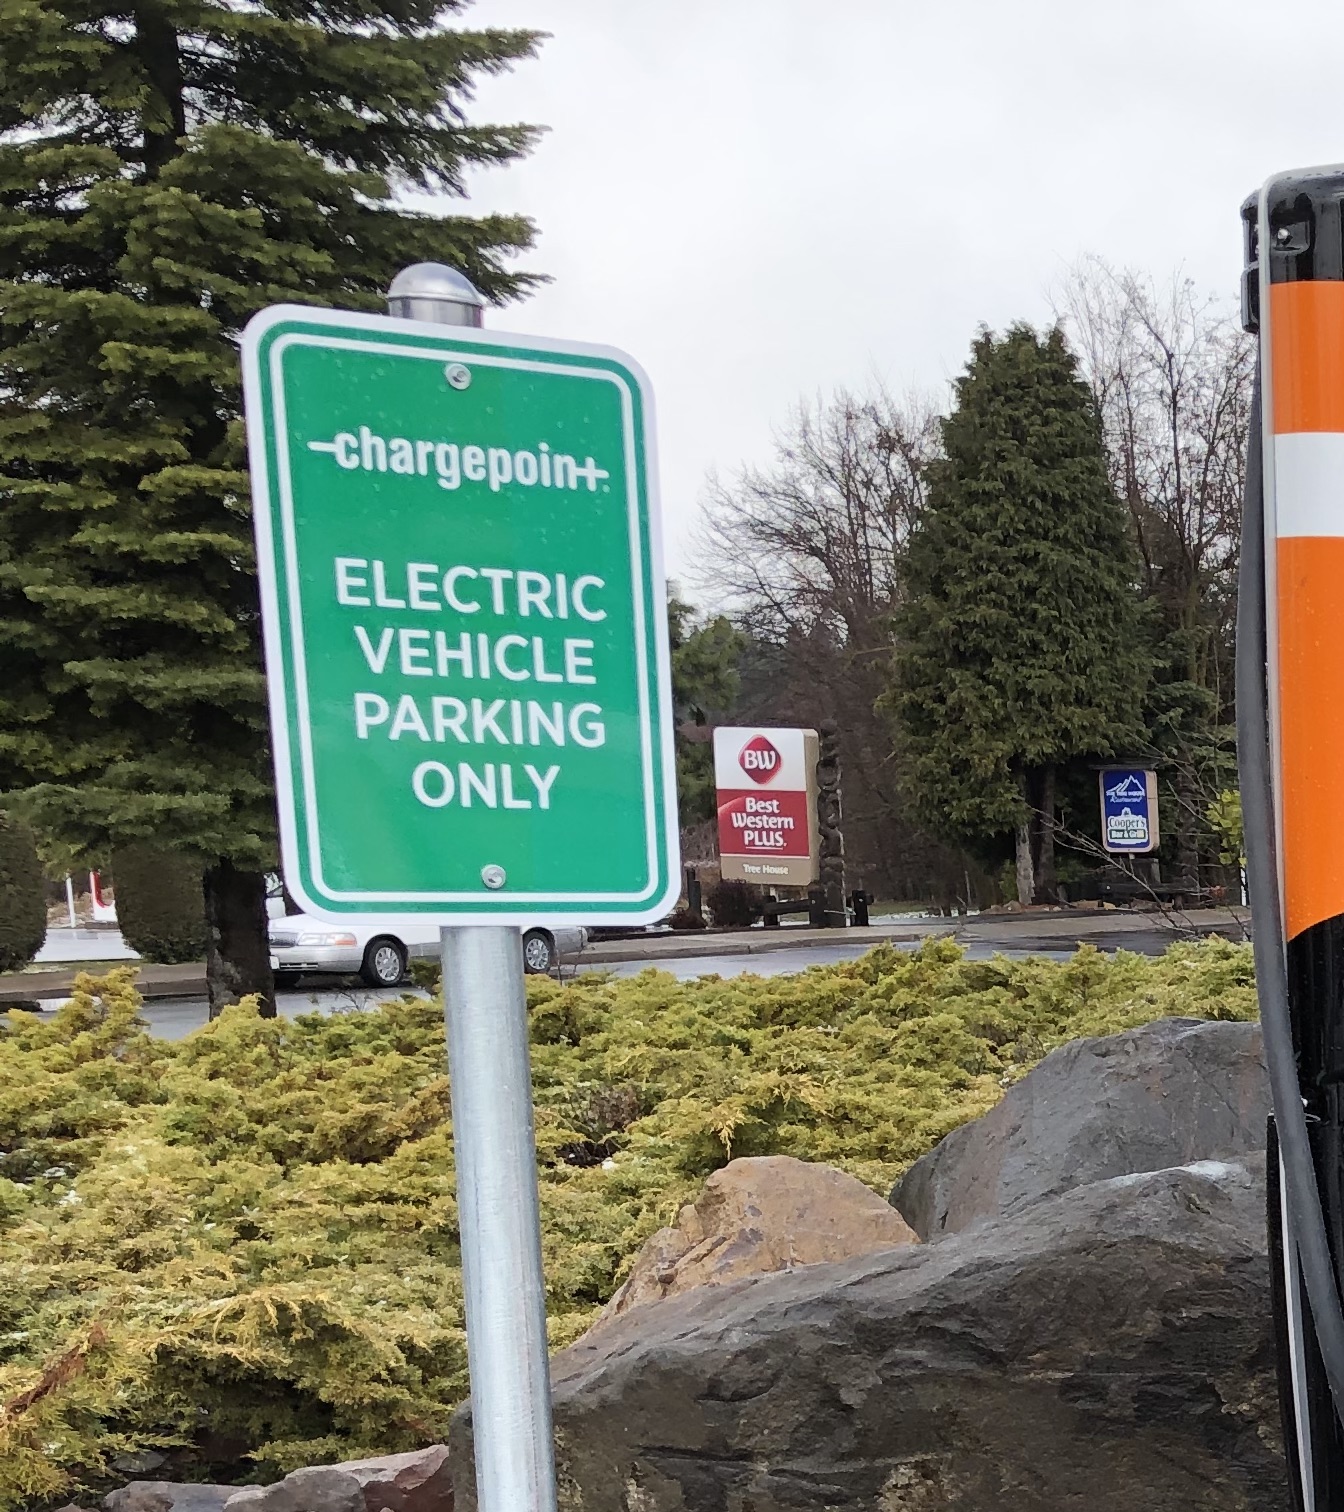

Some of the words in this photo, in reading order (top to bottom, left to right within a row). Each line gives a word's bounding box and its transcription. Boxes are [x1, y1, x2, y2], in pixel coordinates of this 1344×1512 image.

[335, 557, 607, 622] ELECTRIC
[355, 626, 596, 684] VEHICLE
[354, 693, 605, 748] PARKING
[744, 750, 776, 770] BW
[413, 761, 560, 809] ONLY
[731, 813, 794, 830] Western
[745, 797, 780, 813] Best
[743, 864, 761, 873] Tree
[763, 865, 788, 874] House
